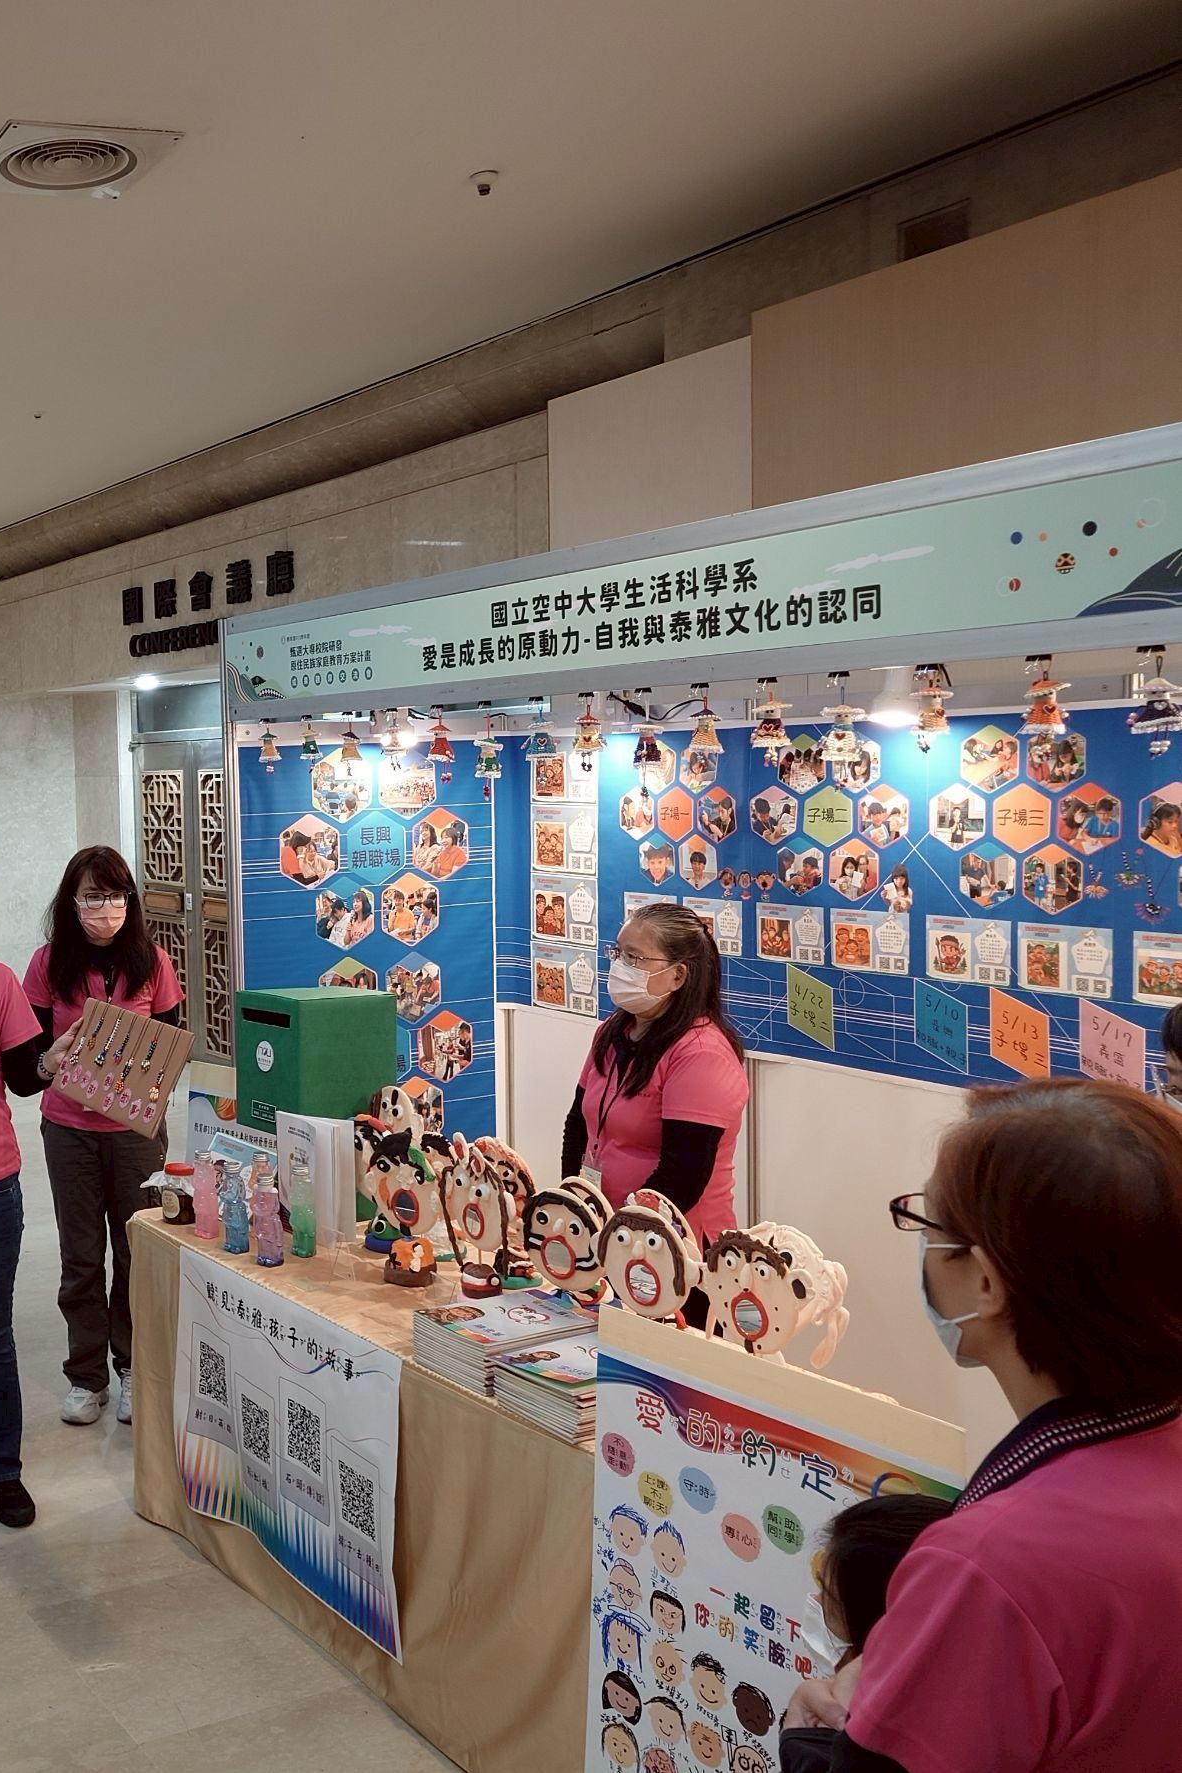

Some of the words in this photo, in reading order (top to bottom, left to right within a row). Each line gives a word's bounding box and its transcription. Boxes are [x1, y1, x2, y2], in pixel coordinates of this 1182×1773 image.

[122, 551, 295, 626] 國際會議廳
[491, 558, 758, 629] 國立空中大學生活科學系
[422, 584, 882, 671] 愛是成長的原動力-自我與泰雅文化的認同
[290, 650, 371, 671] 原住民族家庭教育方案計畫
[659, 806, 691, 822] 子場一
[807, 807, 848, 824] 子場二
[996, 808, 1045, 826] 子場三
[360, 827, 391, 845] 長興
[352, 849, 400, 869] 親職場
[795, 984, 823, 1009] 4/22
[925, 995, 959, 1021] 5/10
[1002, 1011, 1038, 1040] 5/13
[1092, 1016, 1132, 1047] 5/17
[635, 1391, 848, 1503] 愛的約定
[683, 1478, 715, 1497] 守時
[722, 1526, 758, 1548] 專心
[767, 1524, 802, 1547] 同學
[709, 1586, 802, 1643] 一起留下
